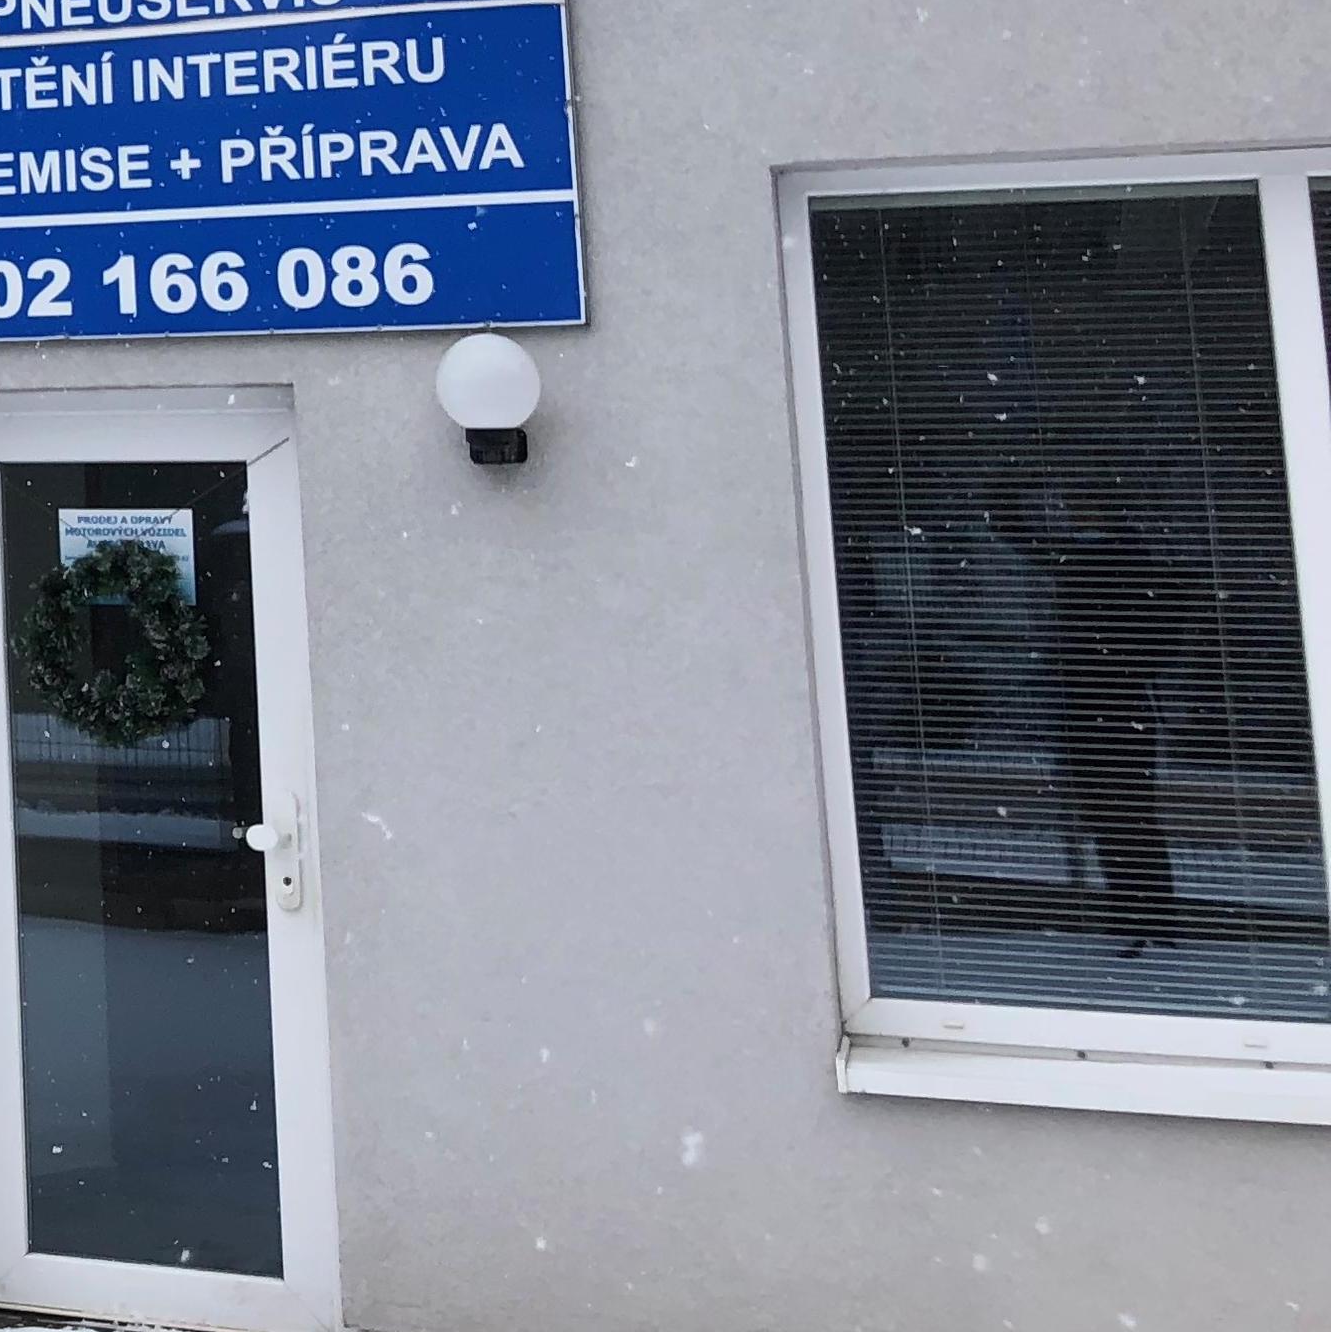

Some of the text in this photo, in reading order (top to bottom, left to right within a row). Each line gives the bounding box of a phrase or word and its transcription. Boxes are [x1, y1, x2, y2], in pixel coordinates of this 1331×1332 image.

[132, 34, 445, 103] INTERIÉRU
[170, 148, 201, 180] +
[220, 123, 524, 186] PŘÍPRAVA
[102, 251, 249, 318] 166
[277, 243, 434, 311] 086
[65, 526, 138, 537] MOTOROVÝCH
[77, 515, 118, 525] PRODEJ
[130, 515, 173, 524] OPRAVY
